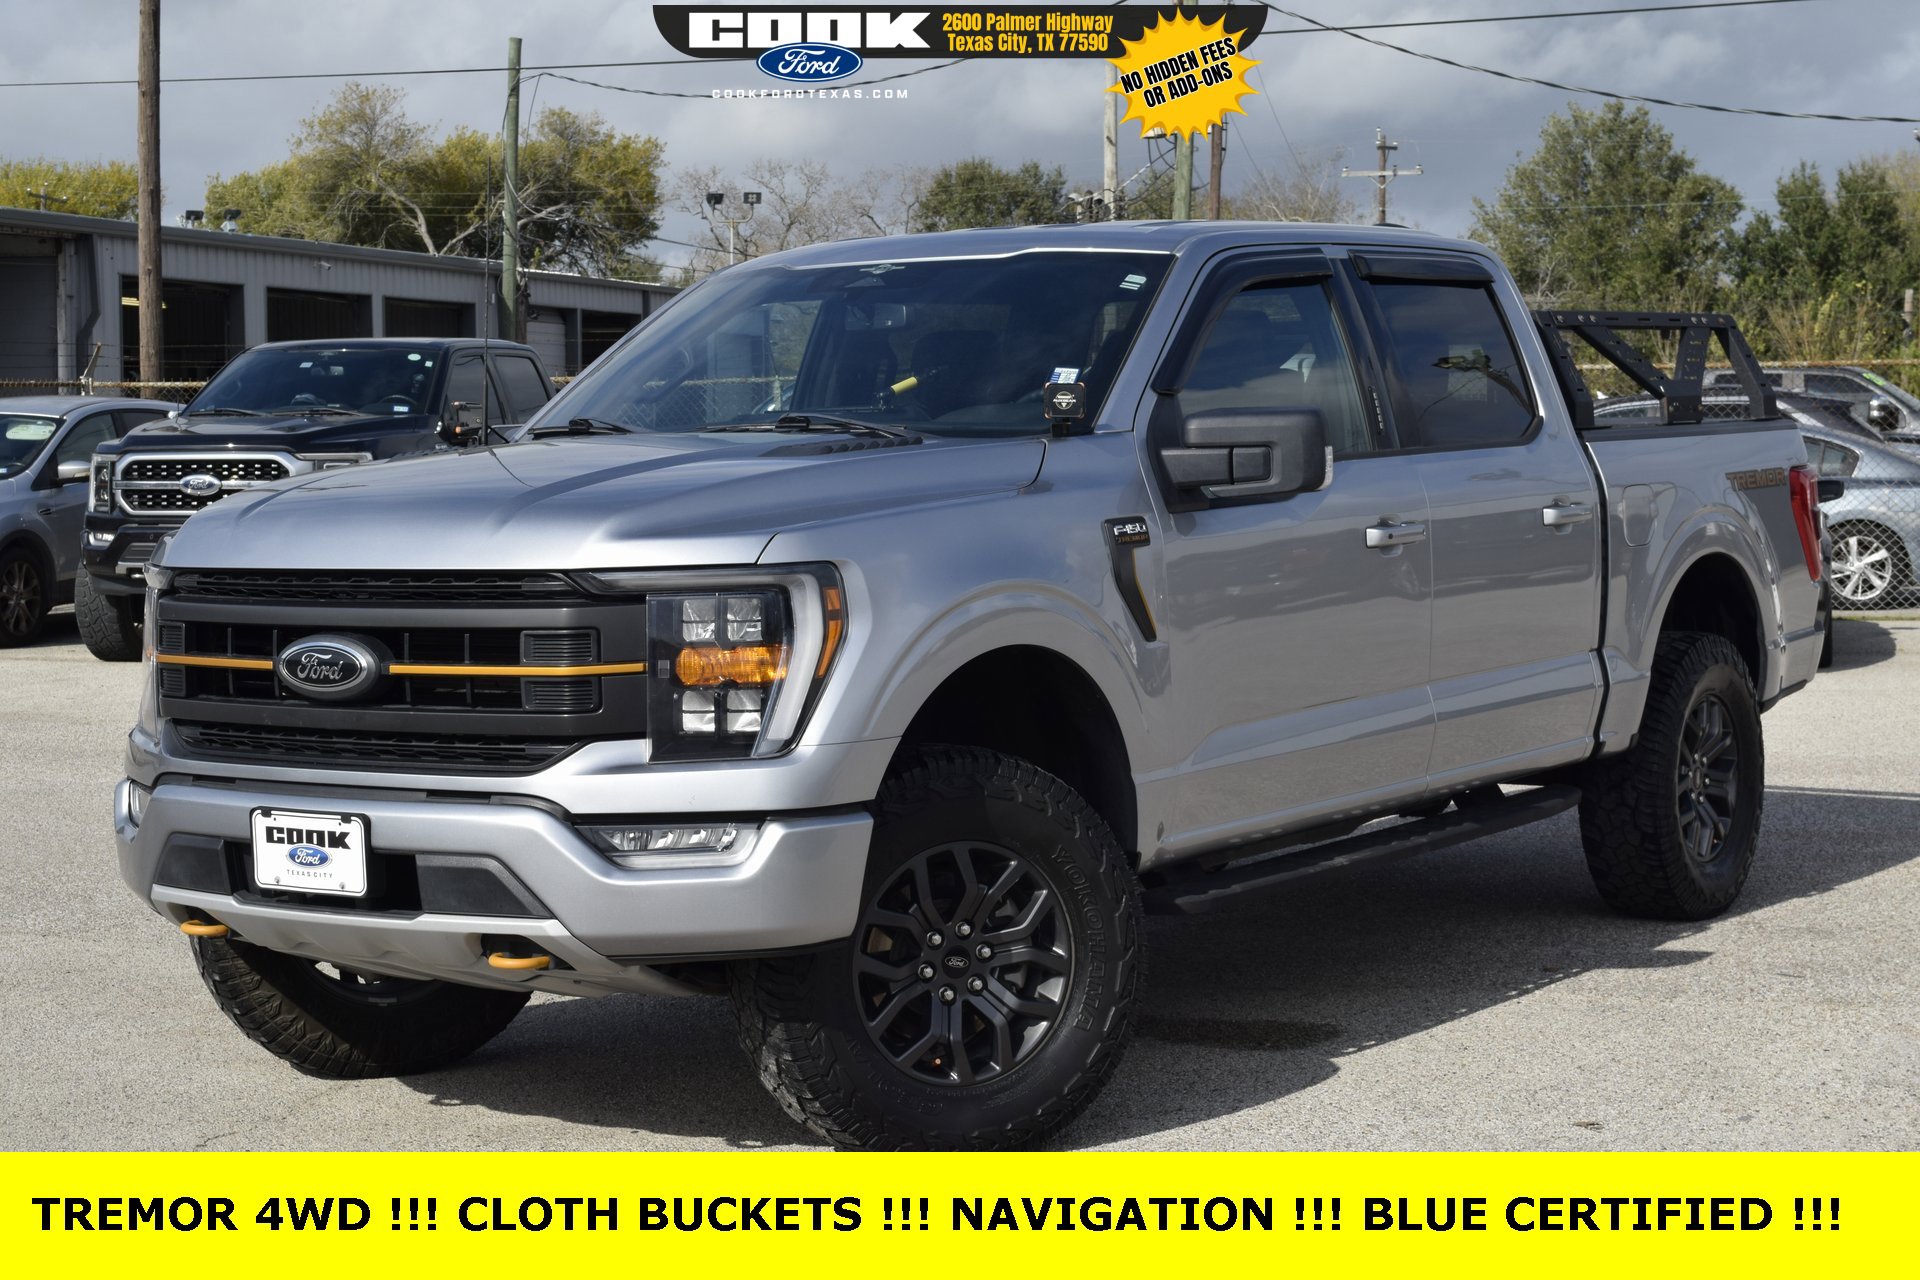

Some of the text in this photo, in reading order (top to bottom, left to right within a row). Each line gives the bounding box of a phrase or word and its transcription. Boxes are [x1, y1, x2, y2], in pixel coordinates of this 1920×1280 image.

[1726, 467, 1786, 491] TREMOR
[1113, 523, 1147, 535] F-150
[296, 652, 344, 680] Ford
[265, 826, 351, 850] COOK
[295, 848, 321, 865] Ford
[287, 869, 311, 877] TEXAS
[1052, 845, 1106, 1032] YOKOHAMA
[948, 958, 965, 967] Ford
